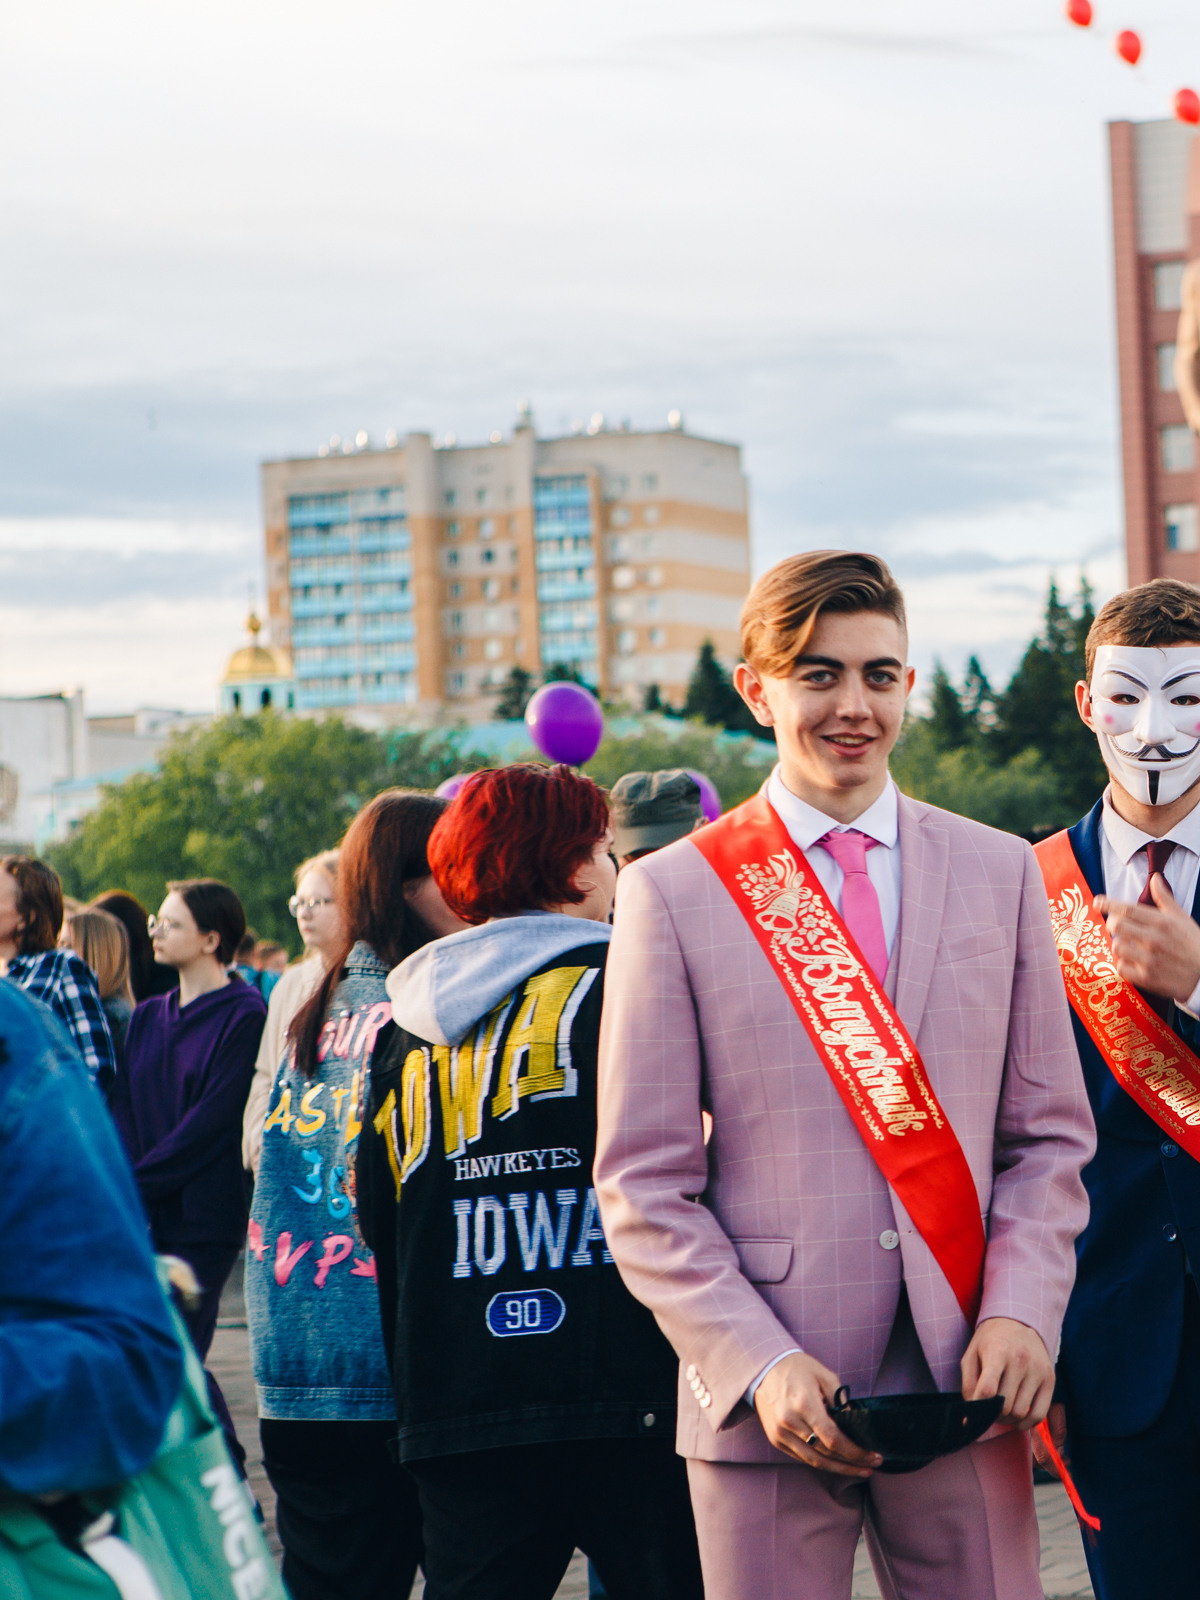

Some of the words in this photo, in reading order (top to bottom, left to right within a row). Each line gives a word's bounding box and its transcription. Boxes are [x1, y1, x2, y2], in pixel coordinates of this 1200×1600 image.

[373, 966, 600, 1202] IOWA
[453, 1146, 582, 1182] HAWKEYES
[452, 1187, 615, 1279] IOWA
[505, 1297, 541, 1329] 90
